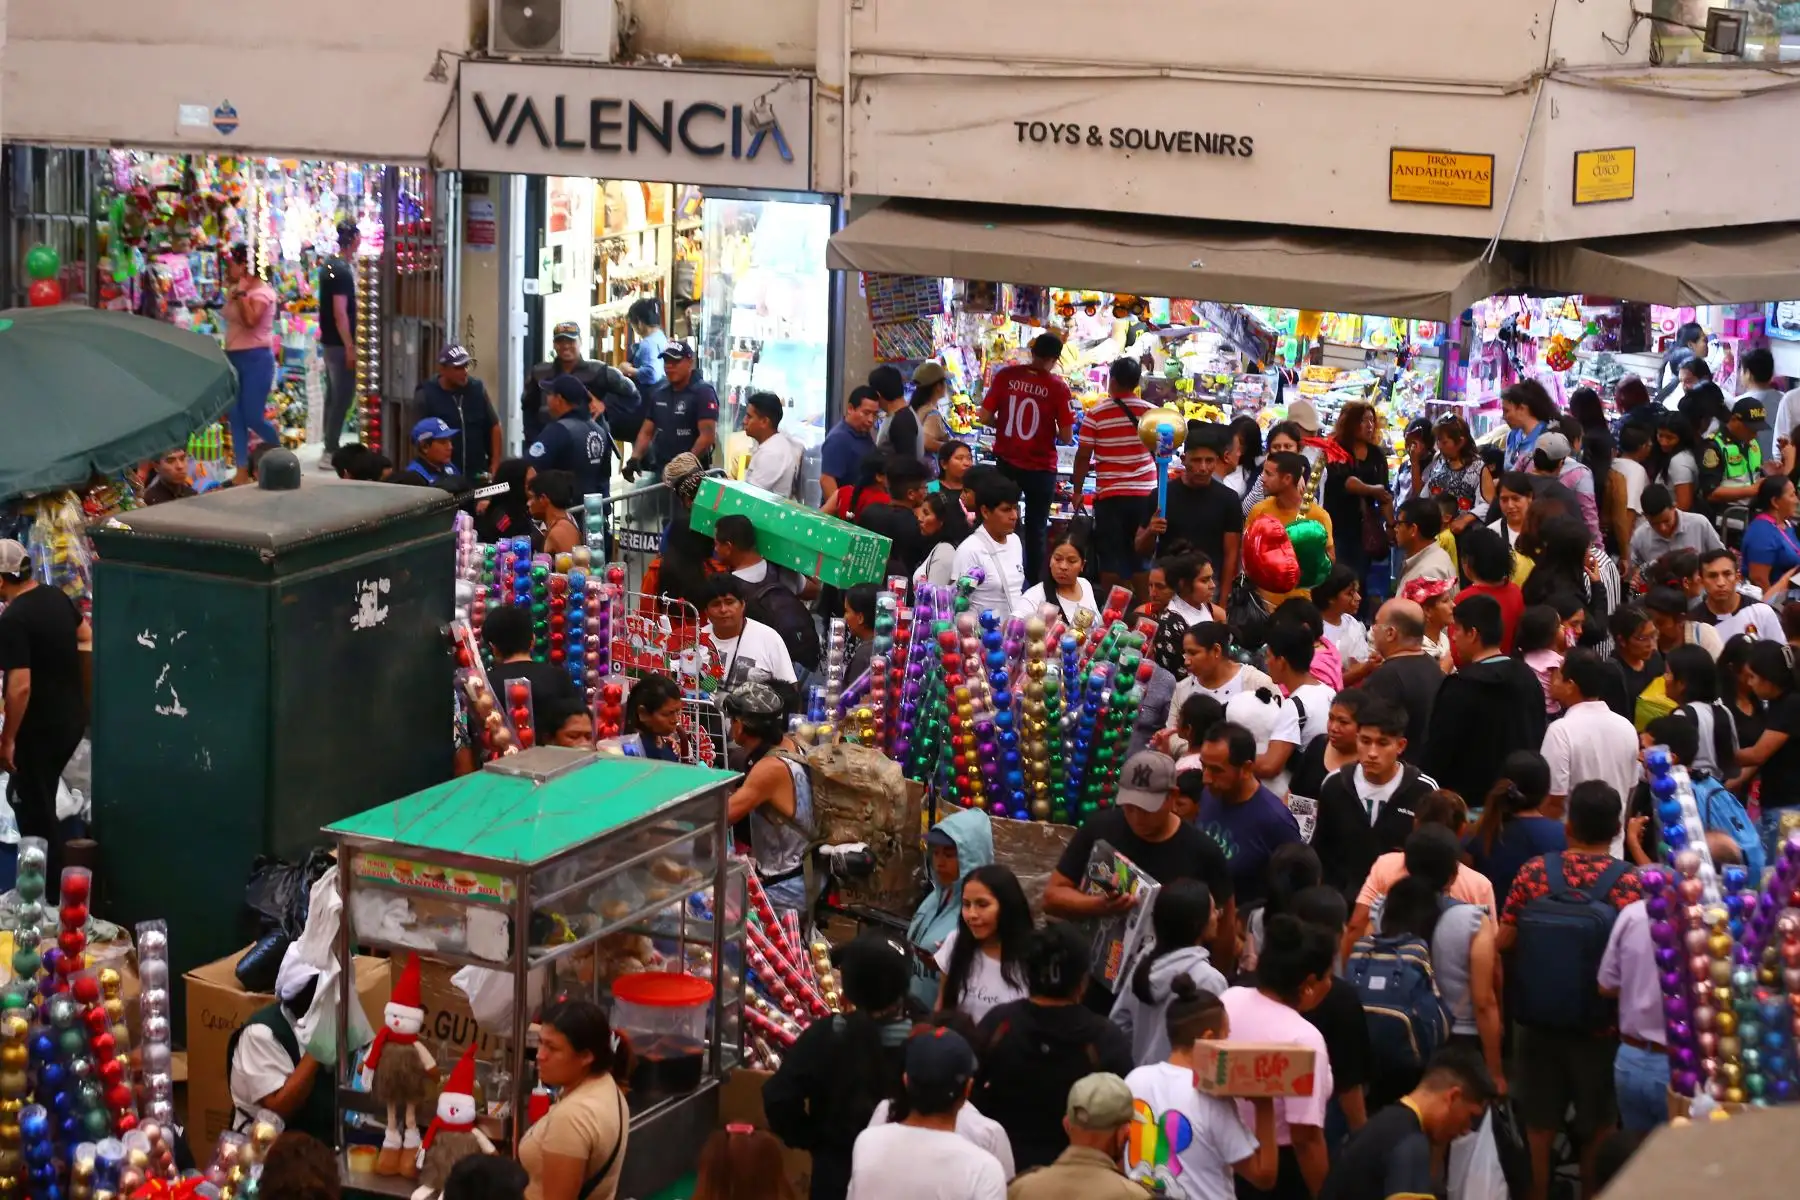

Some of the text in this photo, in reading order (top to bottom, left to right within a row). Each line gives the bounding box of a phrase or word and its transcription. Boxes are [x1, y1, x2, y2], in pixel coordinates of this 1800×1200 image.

[472, 91, 794, 162] VALENCIA
[1014, 121, 1254, 157] TOYS & SOUVENIRS
[1395, 164, 1490, 184] ANDAHUAYLAS
[1592, 164, 1620, 177] CUSCO
[1008, 379, 1049, 397] SOTELDO
[1004, 394, 1040, 441] 10
